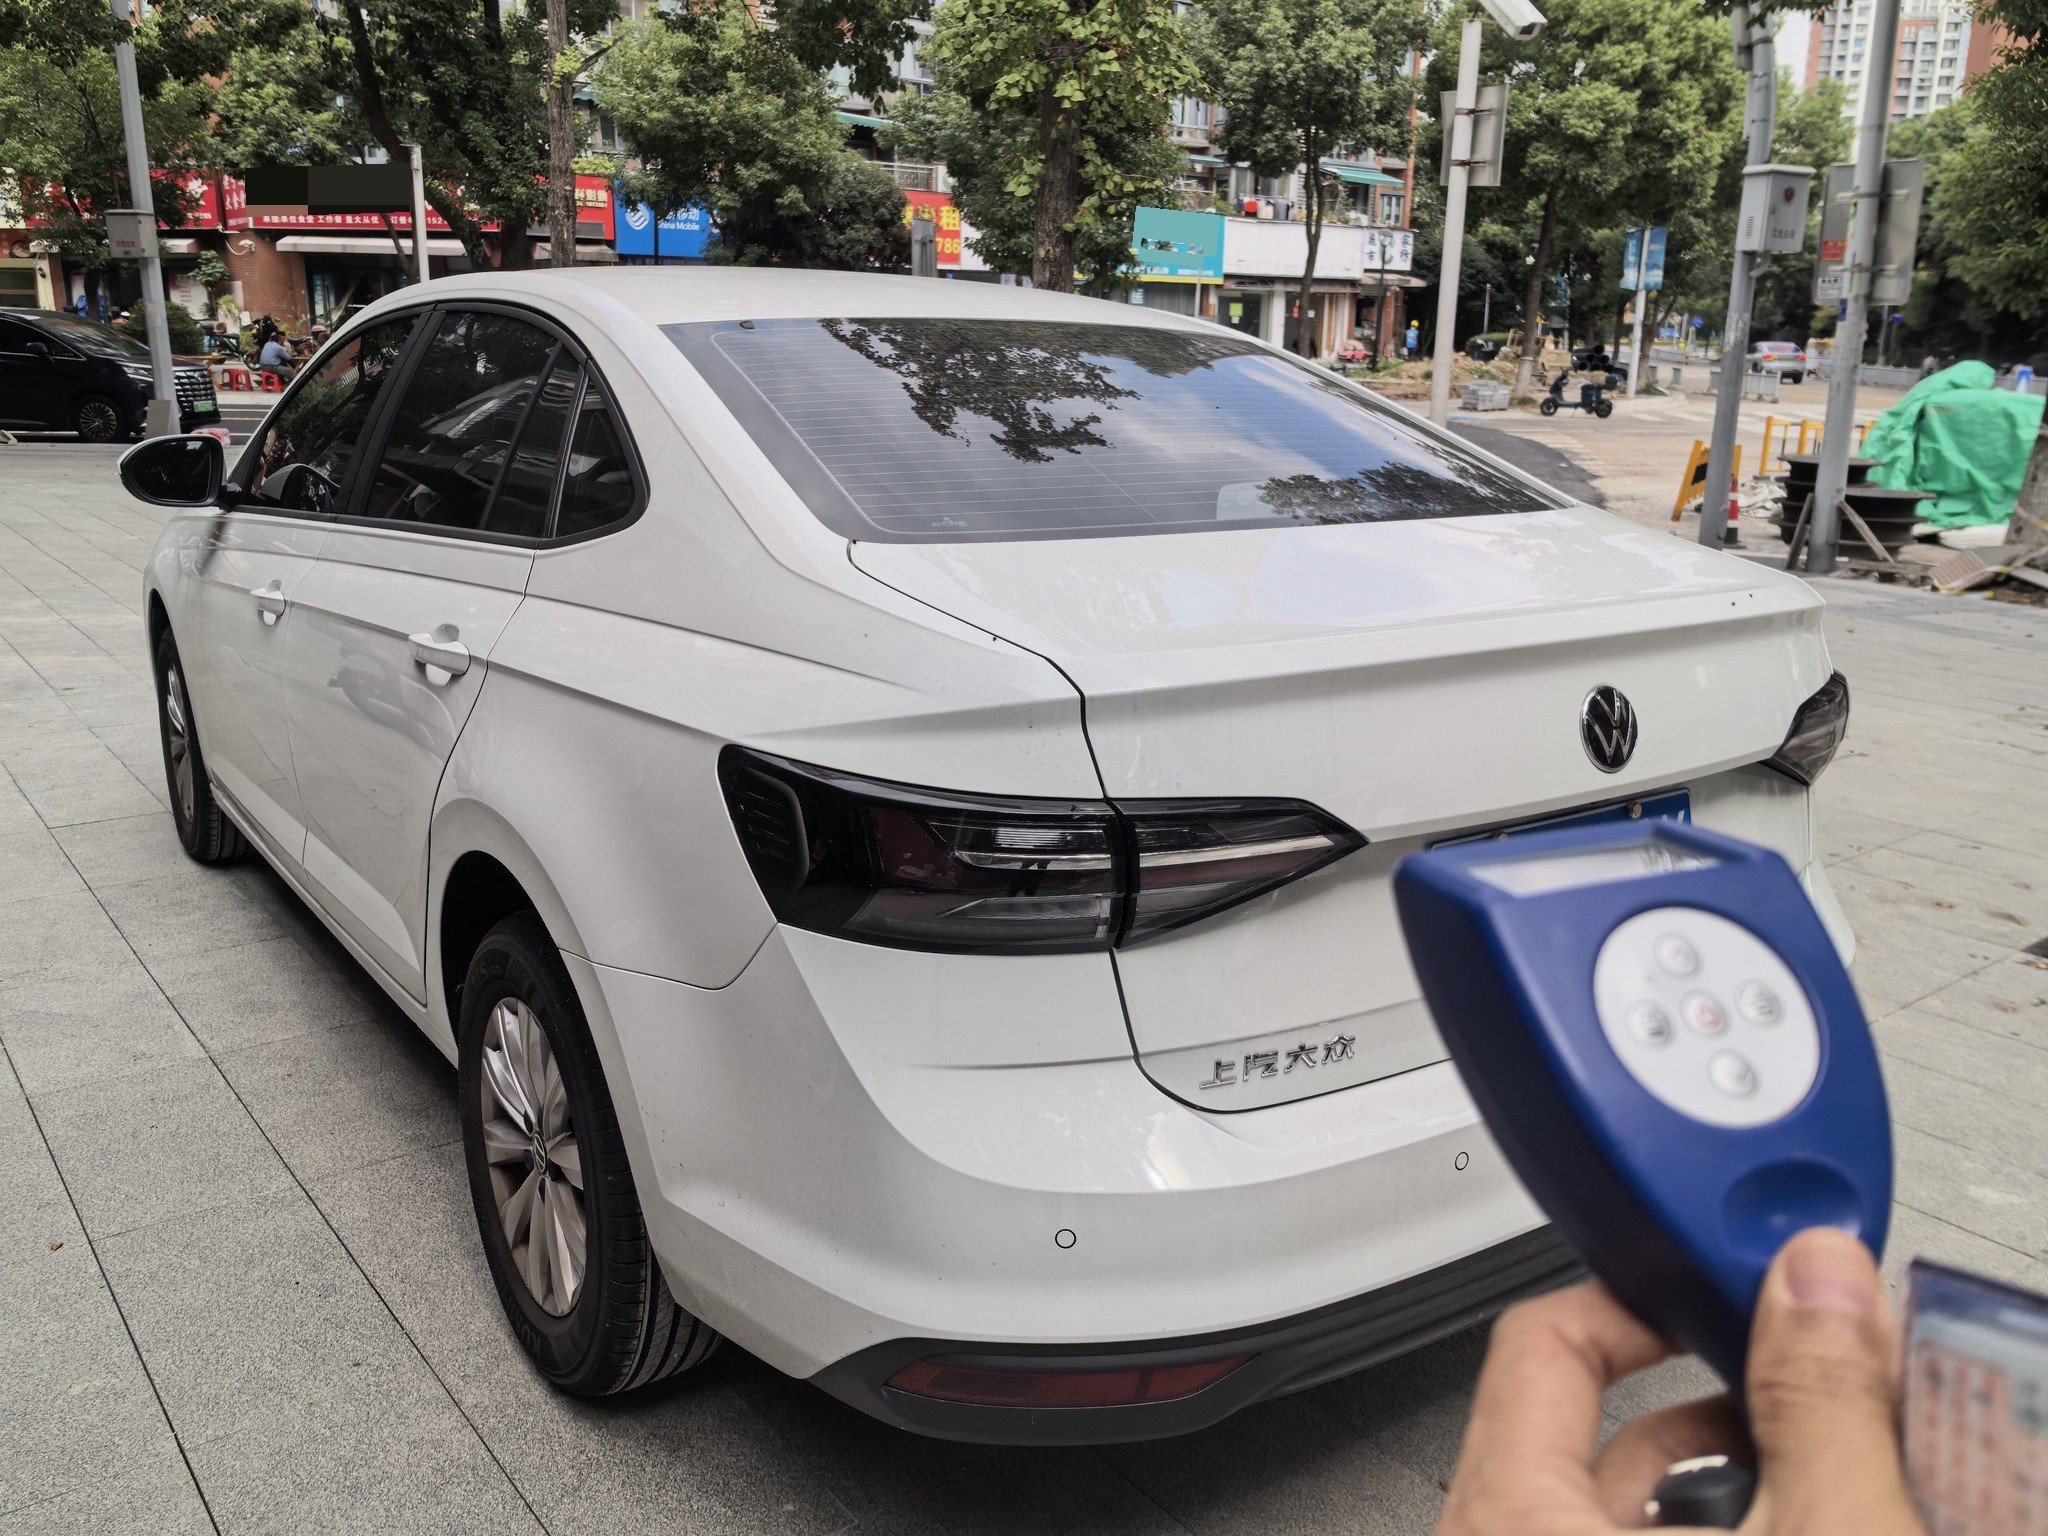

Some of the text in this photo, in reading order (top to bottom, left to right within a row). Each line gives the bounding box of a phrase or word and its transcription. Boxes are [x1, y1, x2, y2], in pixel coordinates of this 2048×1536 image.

[317, 215, 342, 223] 工作餐
[345, 216, 379, 224] 量大从优
[676, 221, 700, 230] Mobile
[1199, 1034, 1356, 1090] 上汽大众
